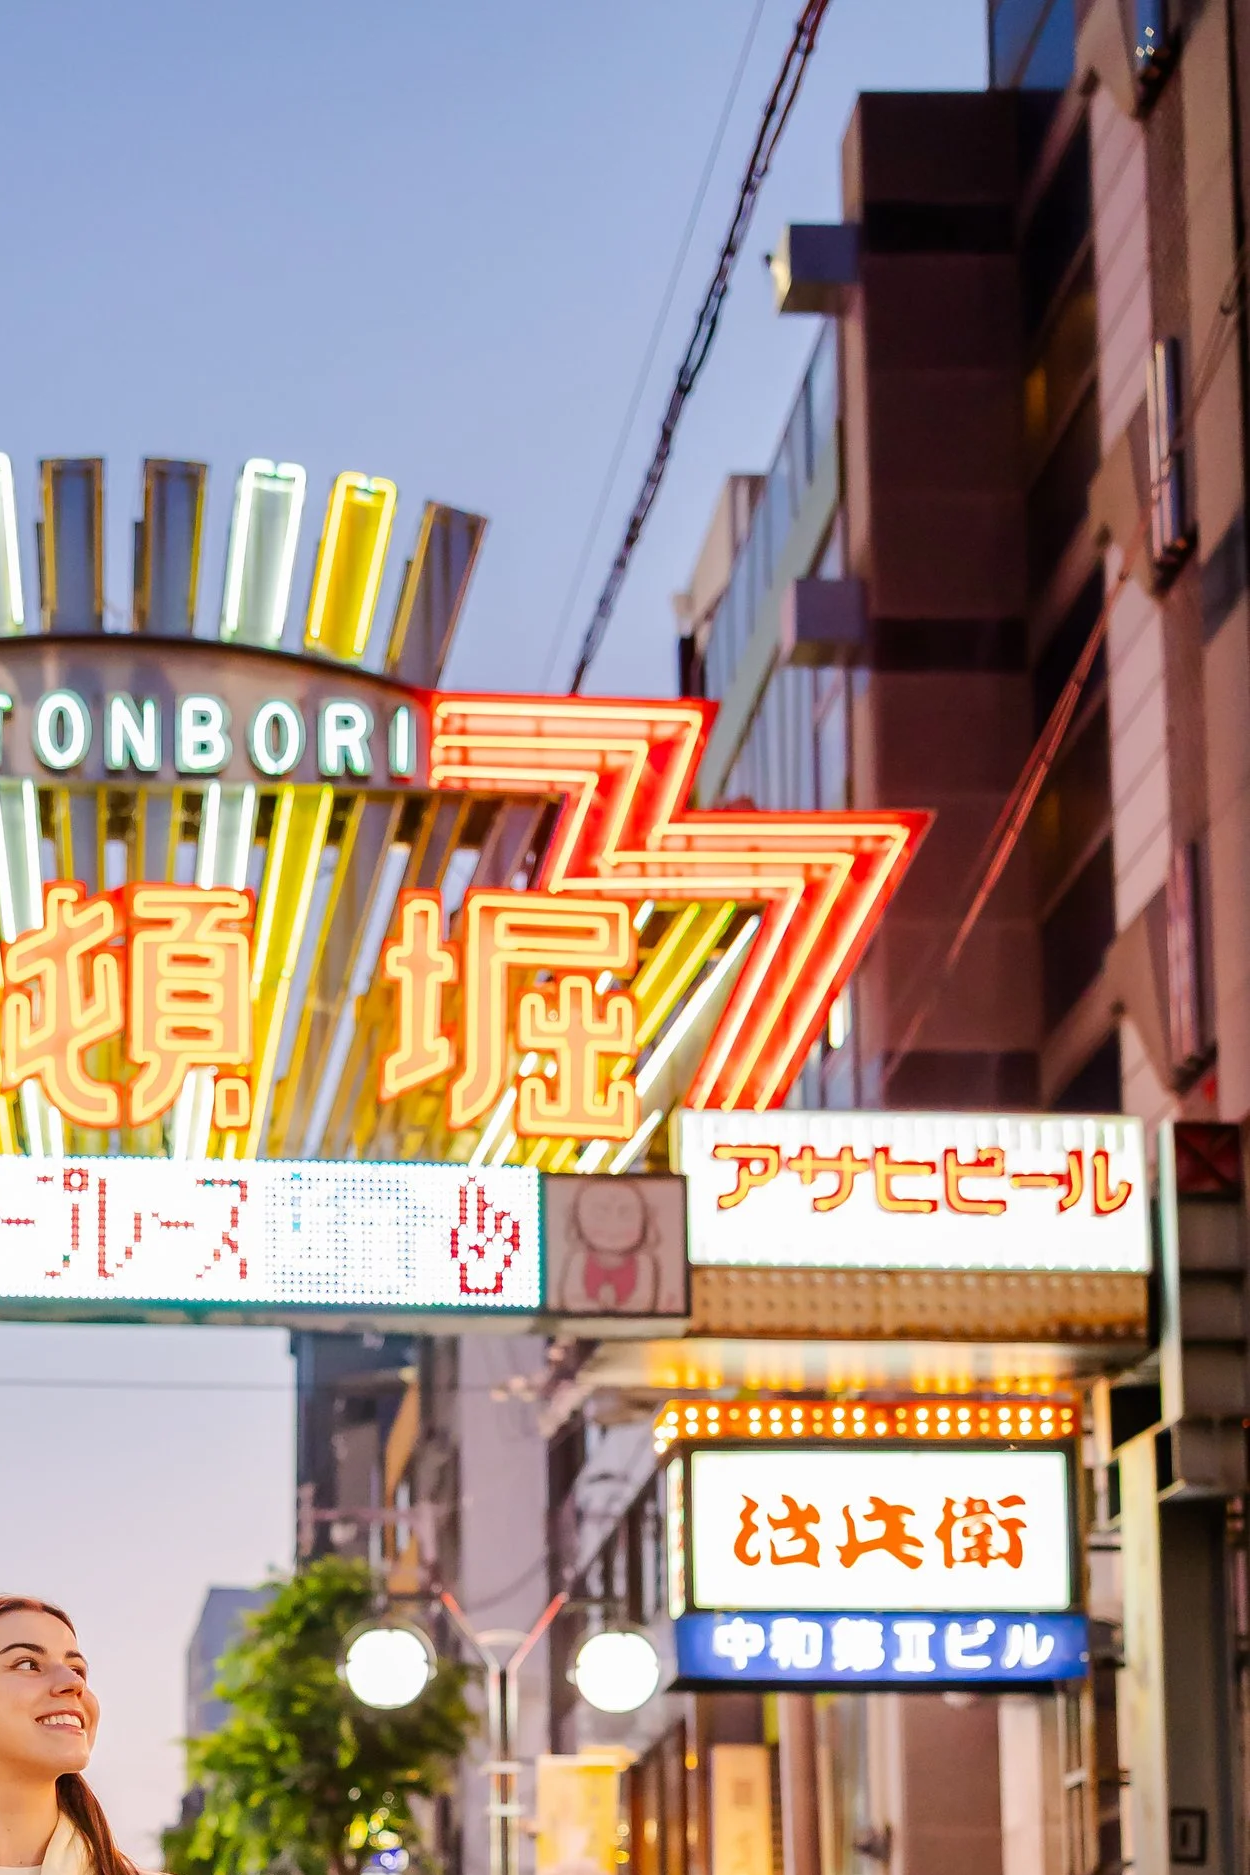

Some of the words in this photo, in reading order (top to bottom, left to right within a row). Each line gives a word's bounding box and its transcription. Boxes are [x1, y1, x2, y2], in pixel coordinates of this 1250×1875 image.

[711, 1143, 1133, 1218] アサヒビール
